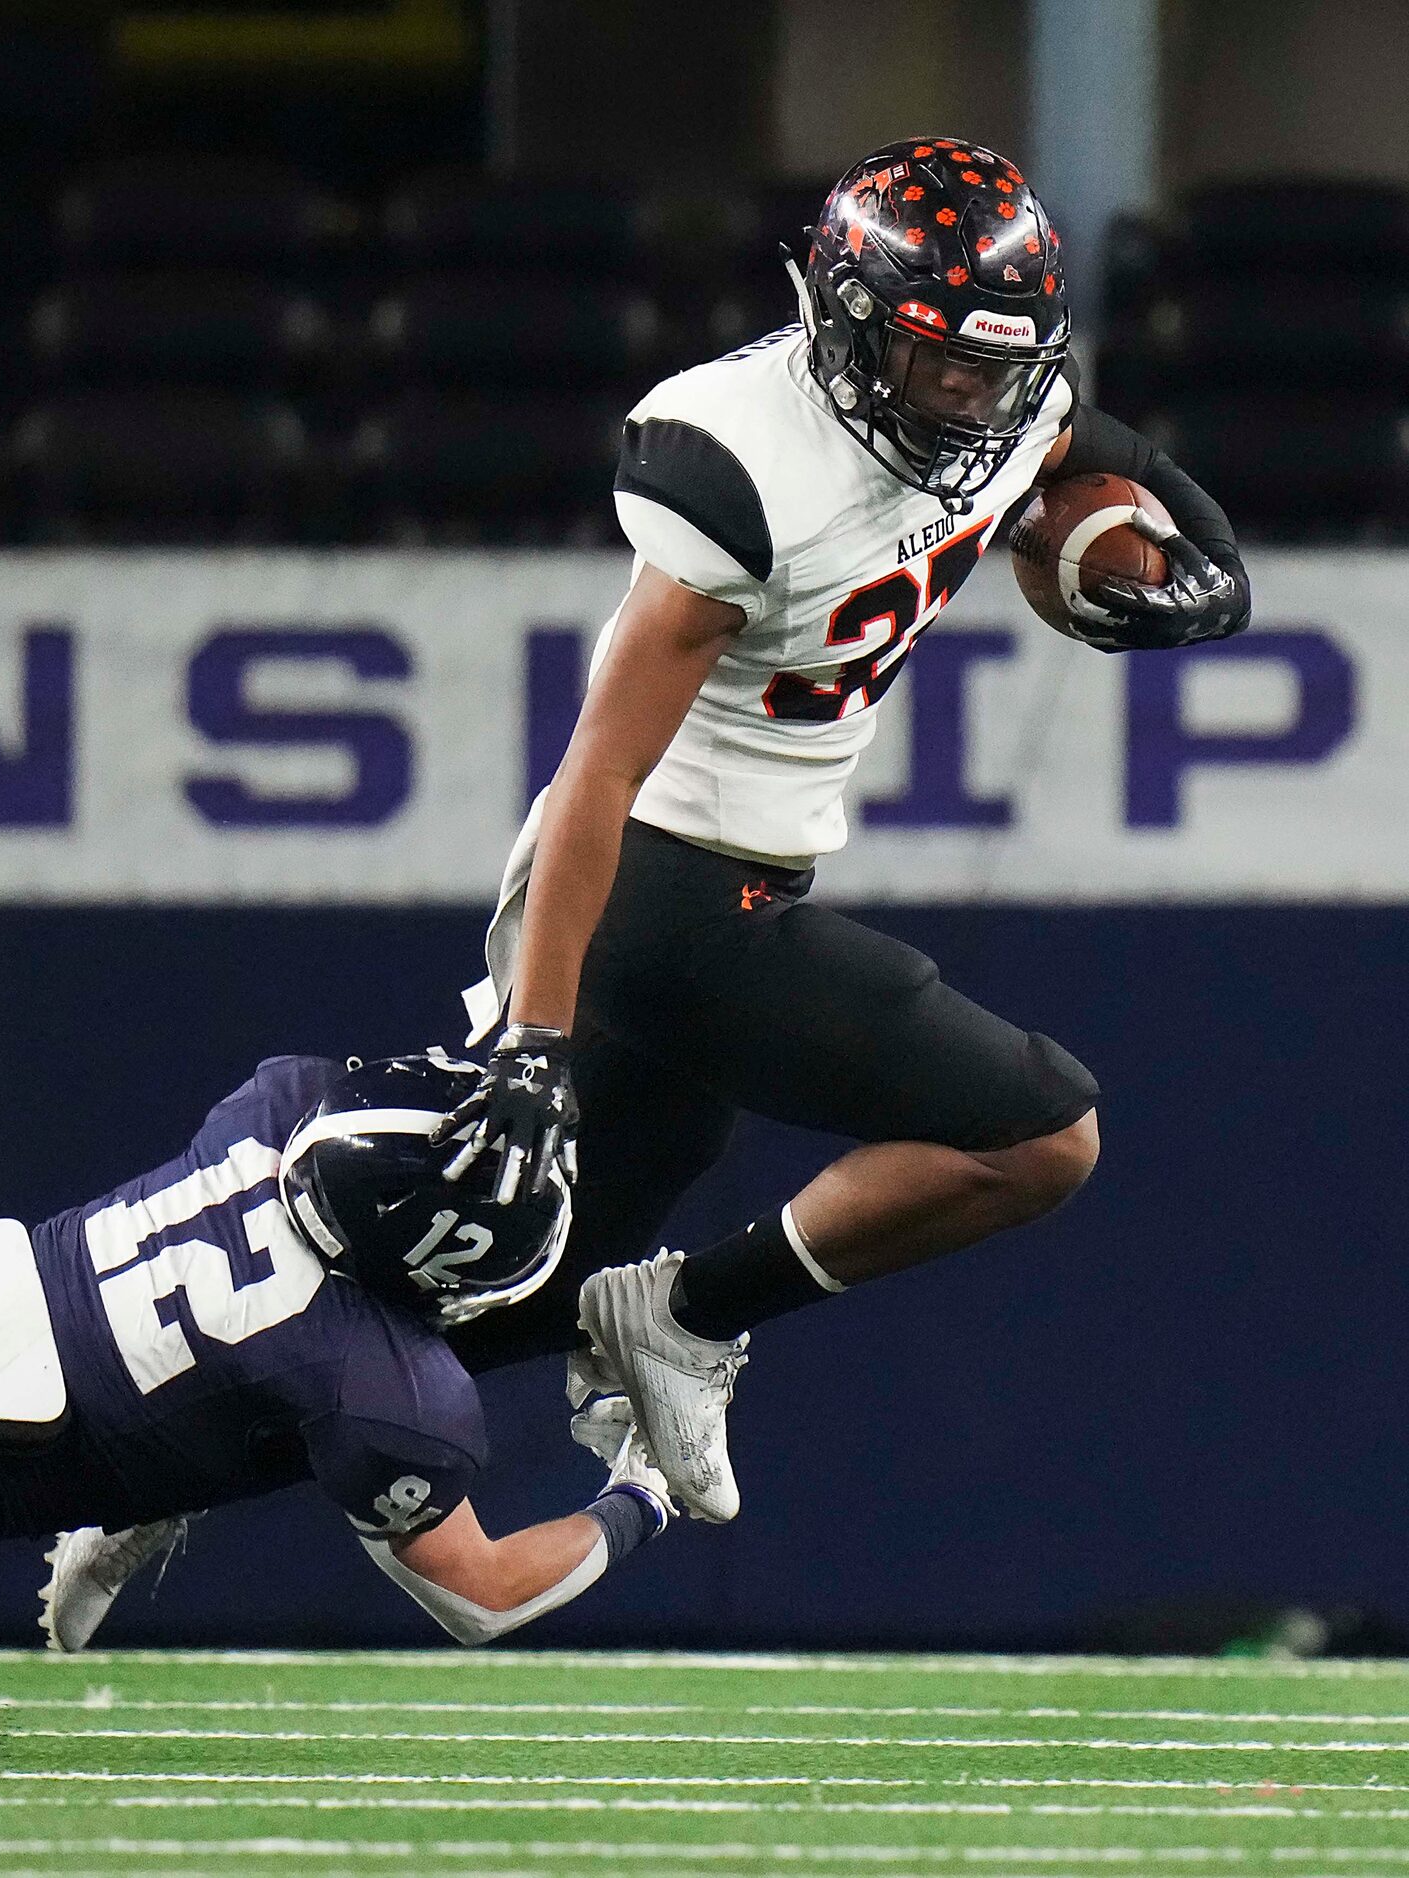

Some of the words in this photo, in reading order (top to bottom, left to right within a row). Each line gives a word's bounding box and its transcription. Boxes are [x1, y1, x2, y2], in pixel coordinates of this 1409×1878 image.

[896, 513, 955, 564] ALEDO
[85, 1136, 325, 1396] 12
[403, 1209, 494, 1290] 12
